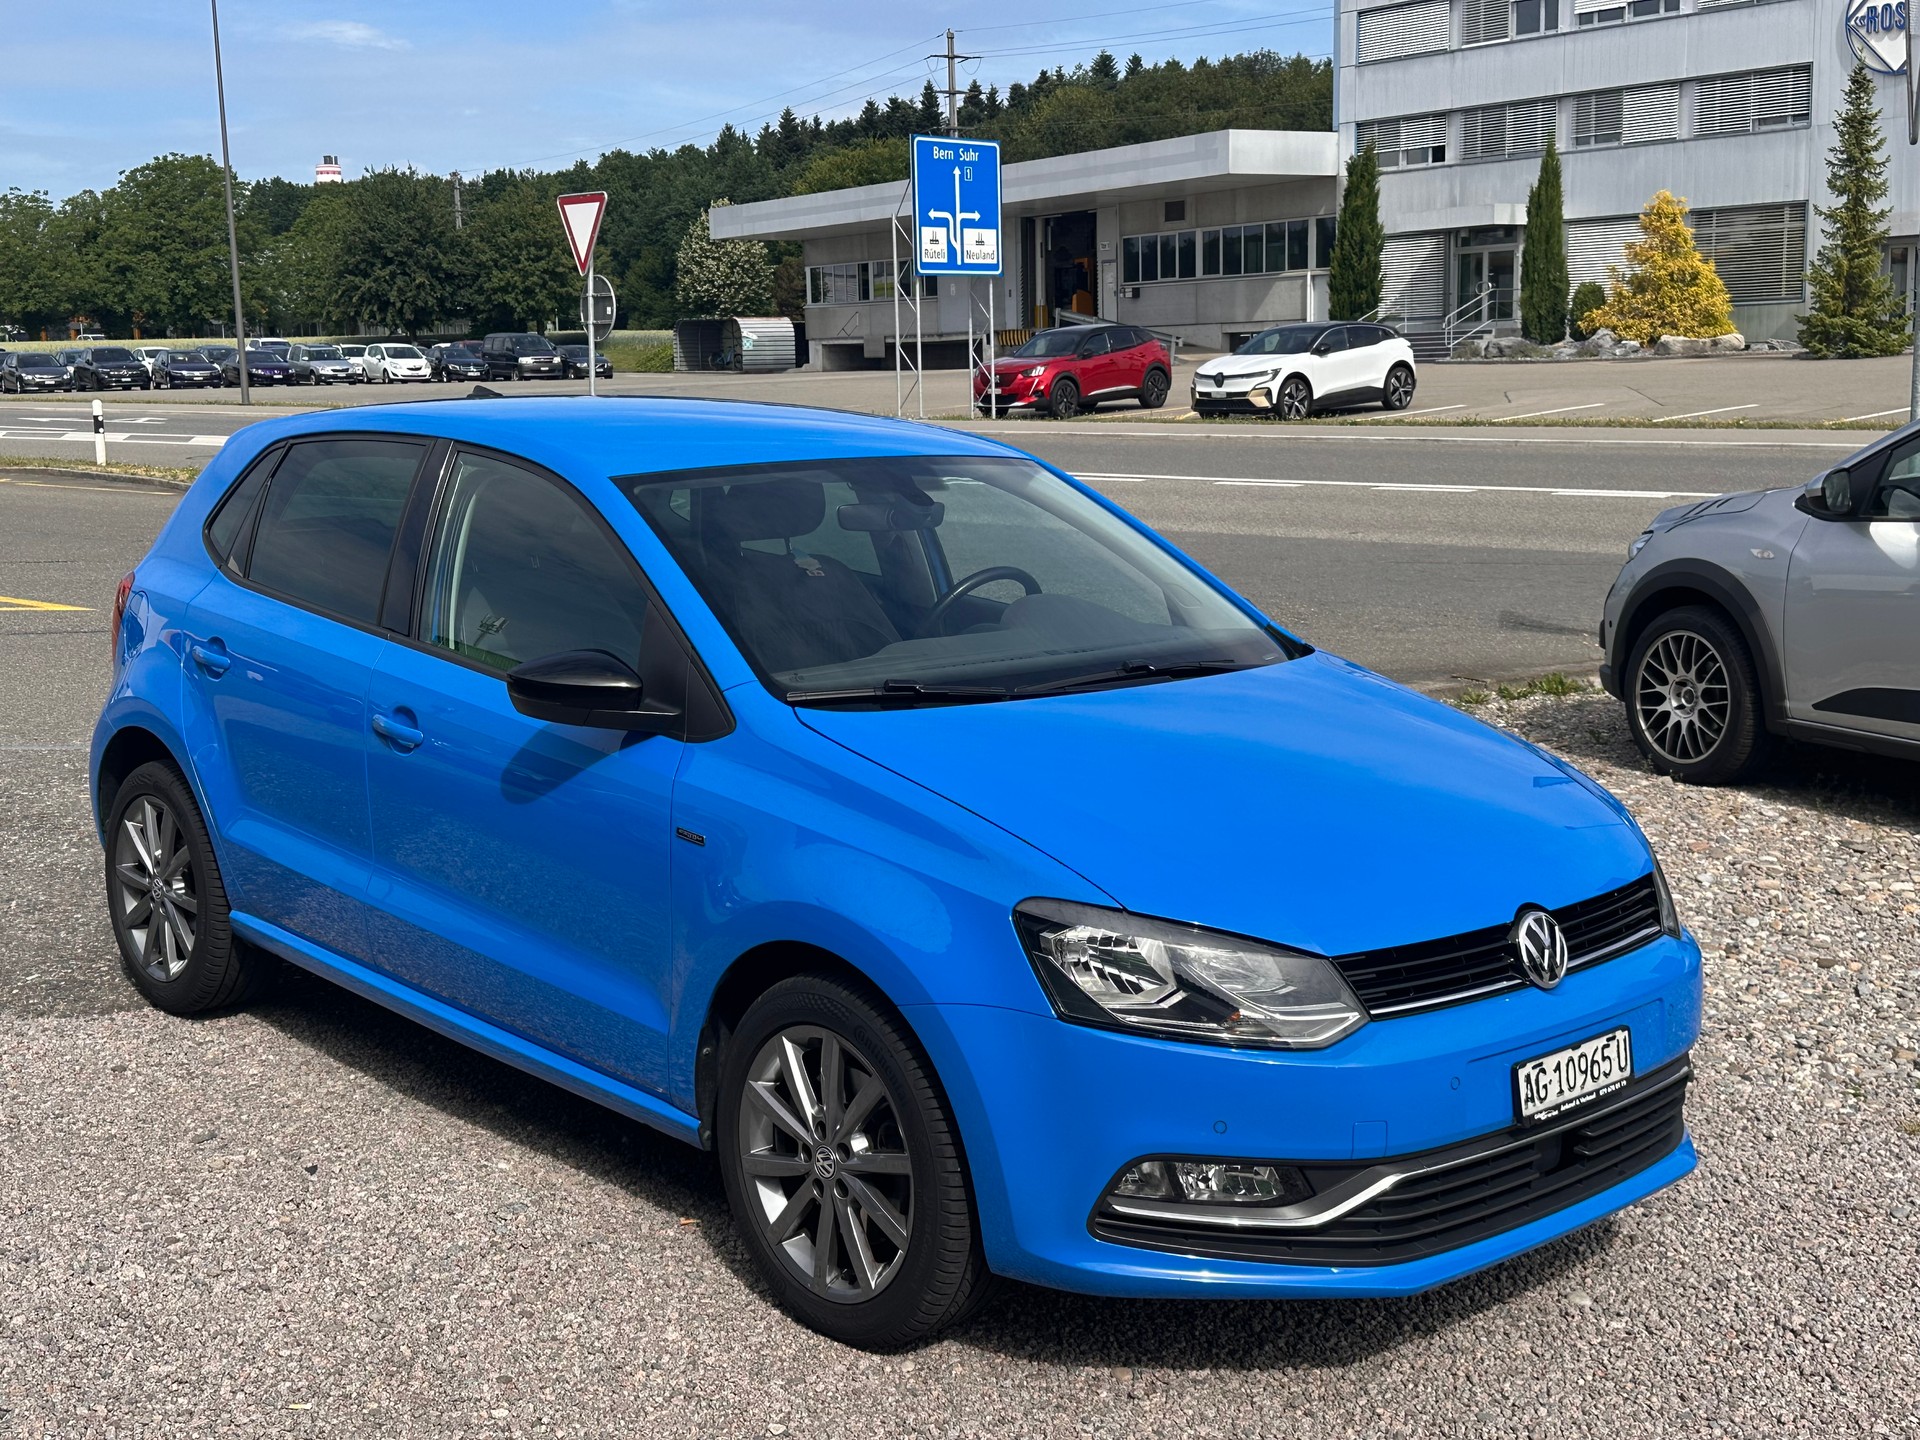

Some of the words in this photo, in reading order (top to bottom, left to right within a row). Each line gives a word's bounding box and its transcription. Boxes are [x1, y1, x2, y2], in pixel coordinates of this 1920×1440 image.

[933, 146, 954, 160] Bern
[959, 148, 980, 162] Suhr
[965, 249, 995, 261] Neuland
